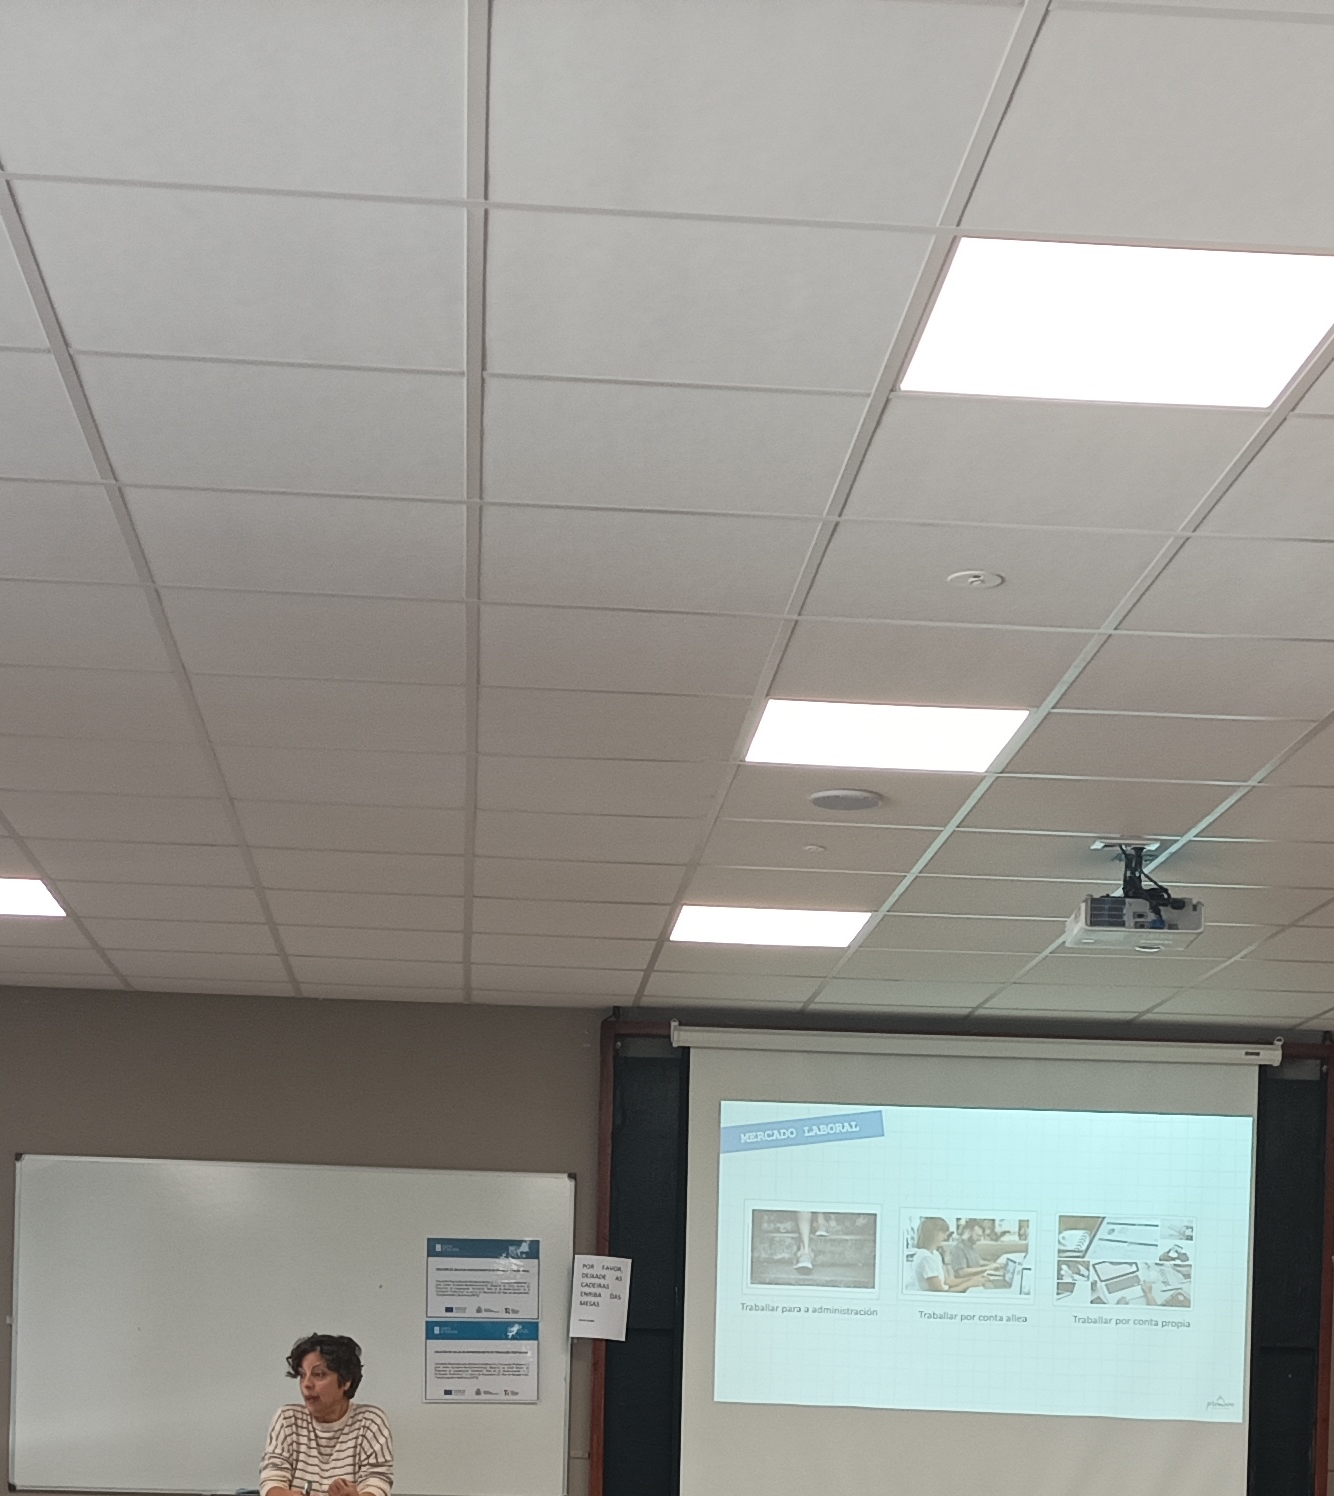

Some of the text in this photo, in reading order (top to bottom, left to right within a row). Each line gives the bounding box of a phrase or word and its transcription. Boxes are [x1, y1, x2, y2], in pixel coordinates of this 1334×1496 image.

[740, 1121, 860, 1143] MERCADO LABORAL
[740, 1302, 780, 1312] Traballar
[781, 1306, 802, 1314] para
[811, 1305, 878, 1316] administración
[918, 1310, 958, 1321] Traballar
[960, 1314, 977, 1323] por
[978, 1313, 1004, 1322] conta
[1073, 1315, 1113, 1325] Traballar
[1133, 1318, 1159, 1327] conta
[1161, 1319, 1191, 1329] propia
